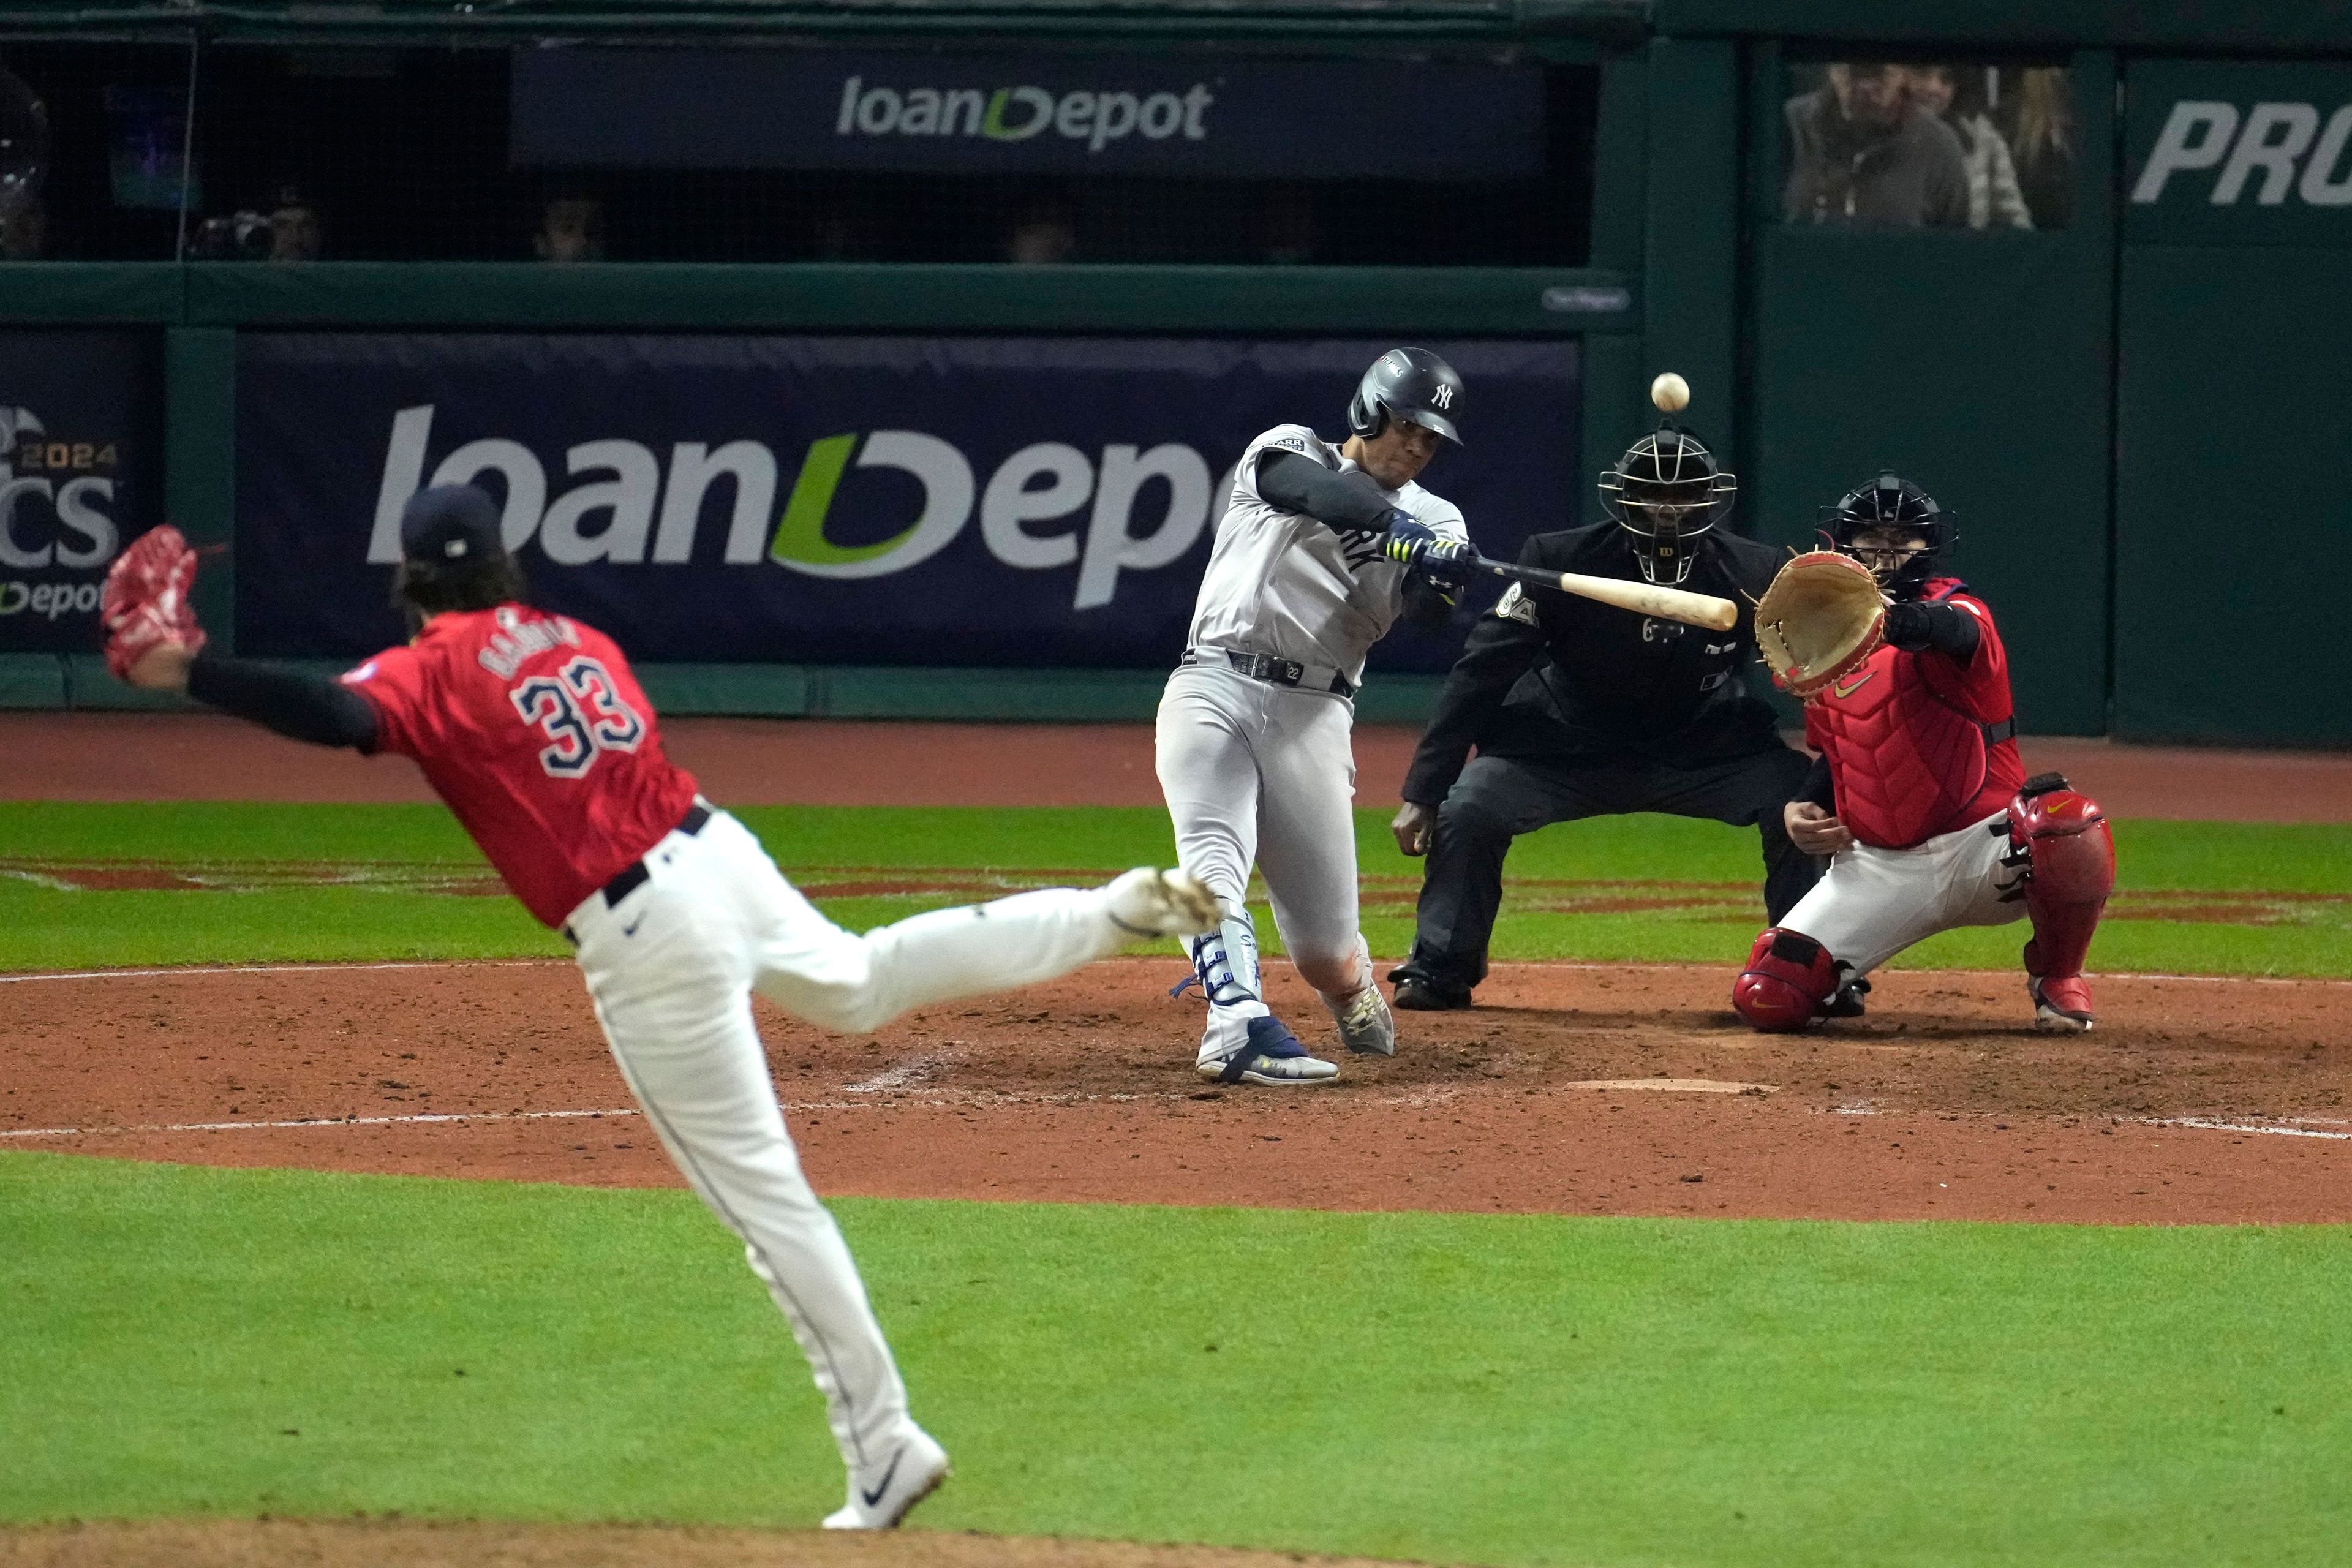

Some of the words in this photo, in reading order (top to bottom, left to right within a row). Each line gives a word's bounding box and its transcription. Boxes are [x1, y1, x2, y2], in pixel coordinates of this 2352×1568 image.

[836, 75, 1214, 152] loanDepot
[1431, 383, 1453, 410] NY
[21, 442, 118, 469] 2024
[368, 404, 1240, 611] loanDep
[0, 581, 108, 621] Depo
[1287, 666, 1298, 680] 22
[509, 655, 645, 779] 33
